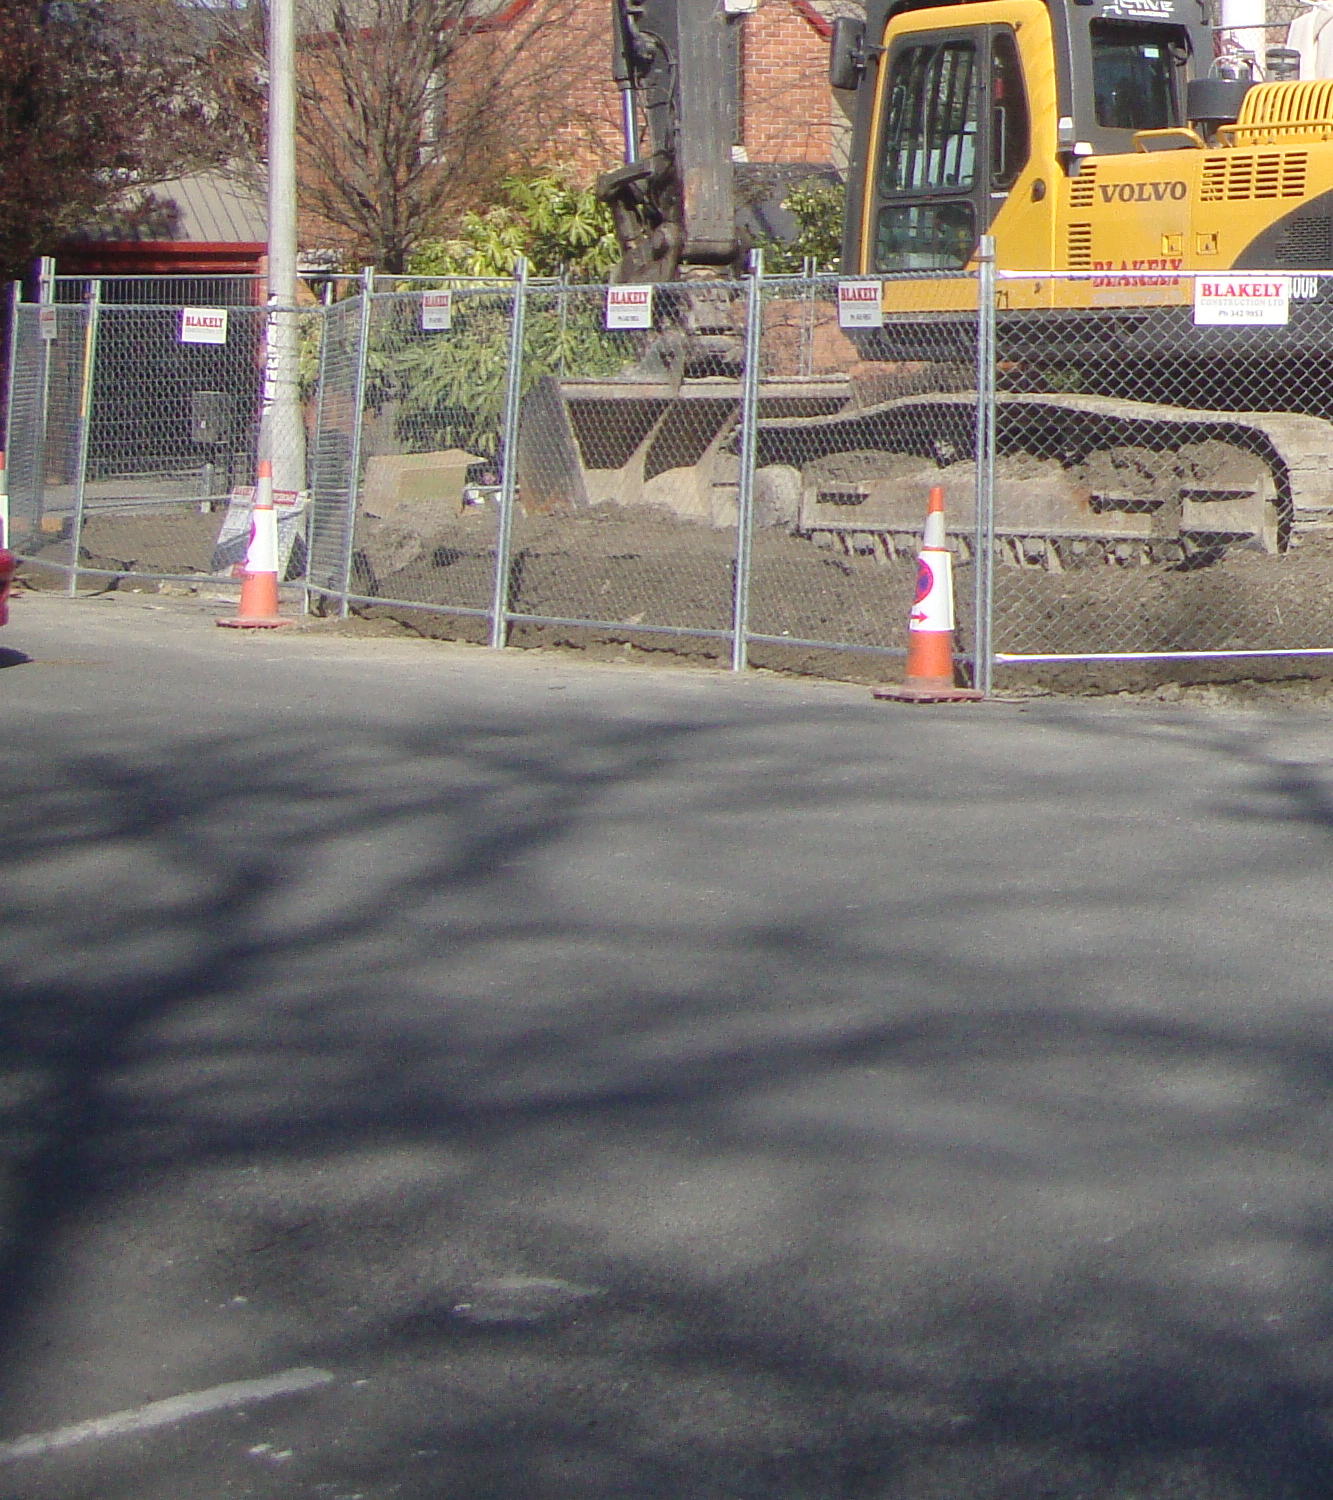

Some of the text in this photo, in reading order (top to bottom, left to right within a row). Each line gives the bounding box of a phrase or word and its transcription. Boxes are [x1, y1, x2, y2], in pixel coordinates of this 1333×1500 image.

[1099, 180, 1187, 203] VOLVO
[840, 287, 879, 301] BLAKELY
[1201, 283, 1283, 297] BLAKELY
[610, 291, 649, 304] BLAKELY
[1200, 298, 1284, 307] CONSTRUCTION LTD
[1218, 309, 1229, 317] Ph
[185, 315, 224, 329] BLAKELY
